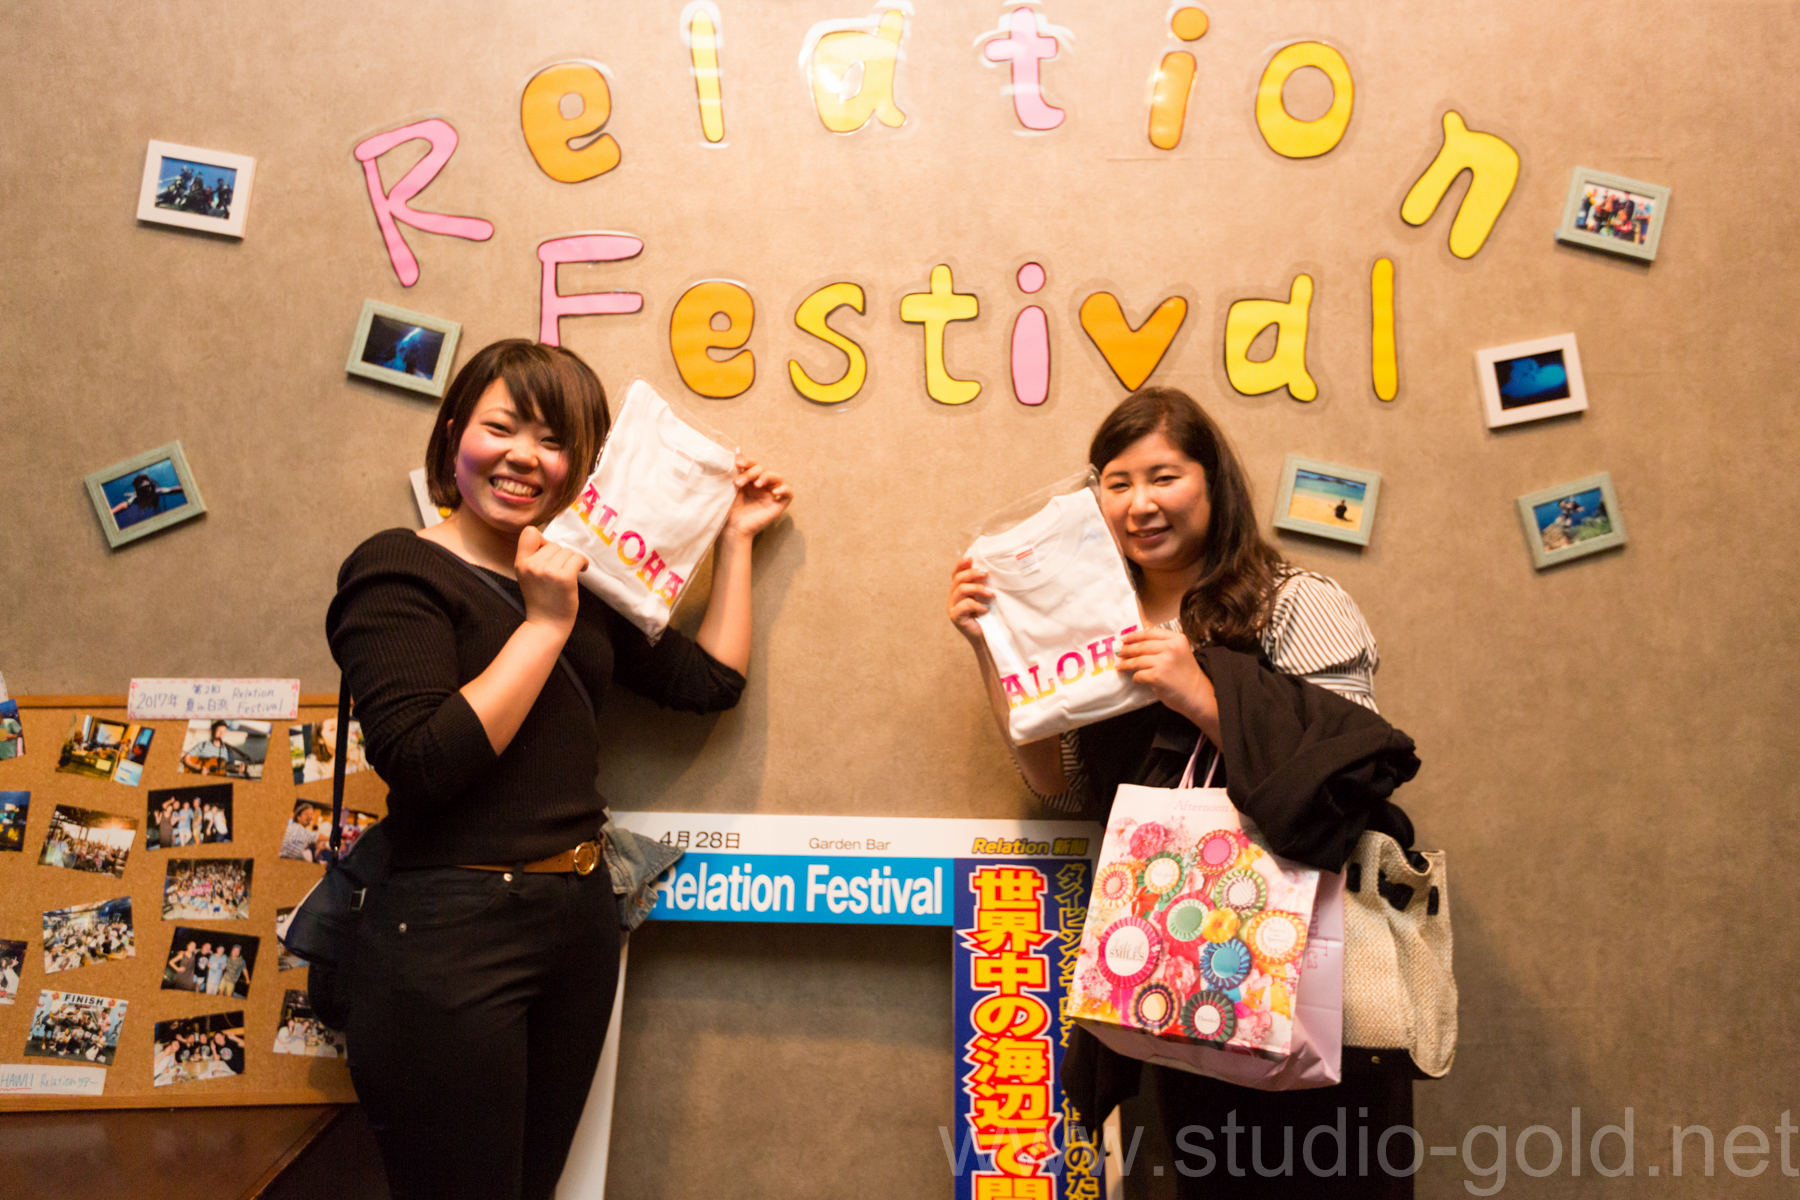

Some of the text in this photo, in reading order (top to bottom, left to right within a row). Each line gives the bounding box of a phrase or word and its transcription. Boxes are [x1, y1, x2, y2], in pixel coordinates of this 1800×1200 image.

[354, 6, 1520, 287] Relation
[569, 482, 685, 607] ALOHA
[1001, 624, 1138, 710] ALOH
[136, 692, 179, 710] 2017年
[233, 687, 275, 700] Relation
[237, 698, 284, 715] Festival
[1174, 799, 1229, 813] Afternoon
[659, 831, 741, 849] 4月28日
[808, 837, 892, 851] Garden Bar
[971, 837, 1050, 855] Relation
[653, 862, 943, 915] Relation Festival
[1109, 948, 1145, 962] SMILES
[1306, 938, 1329, 970] Tea
[64, 993, 104, 1006] FINISH
